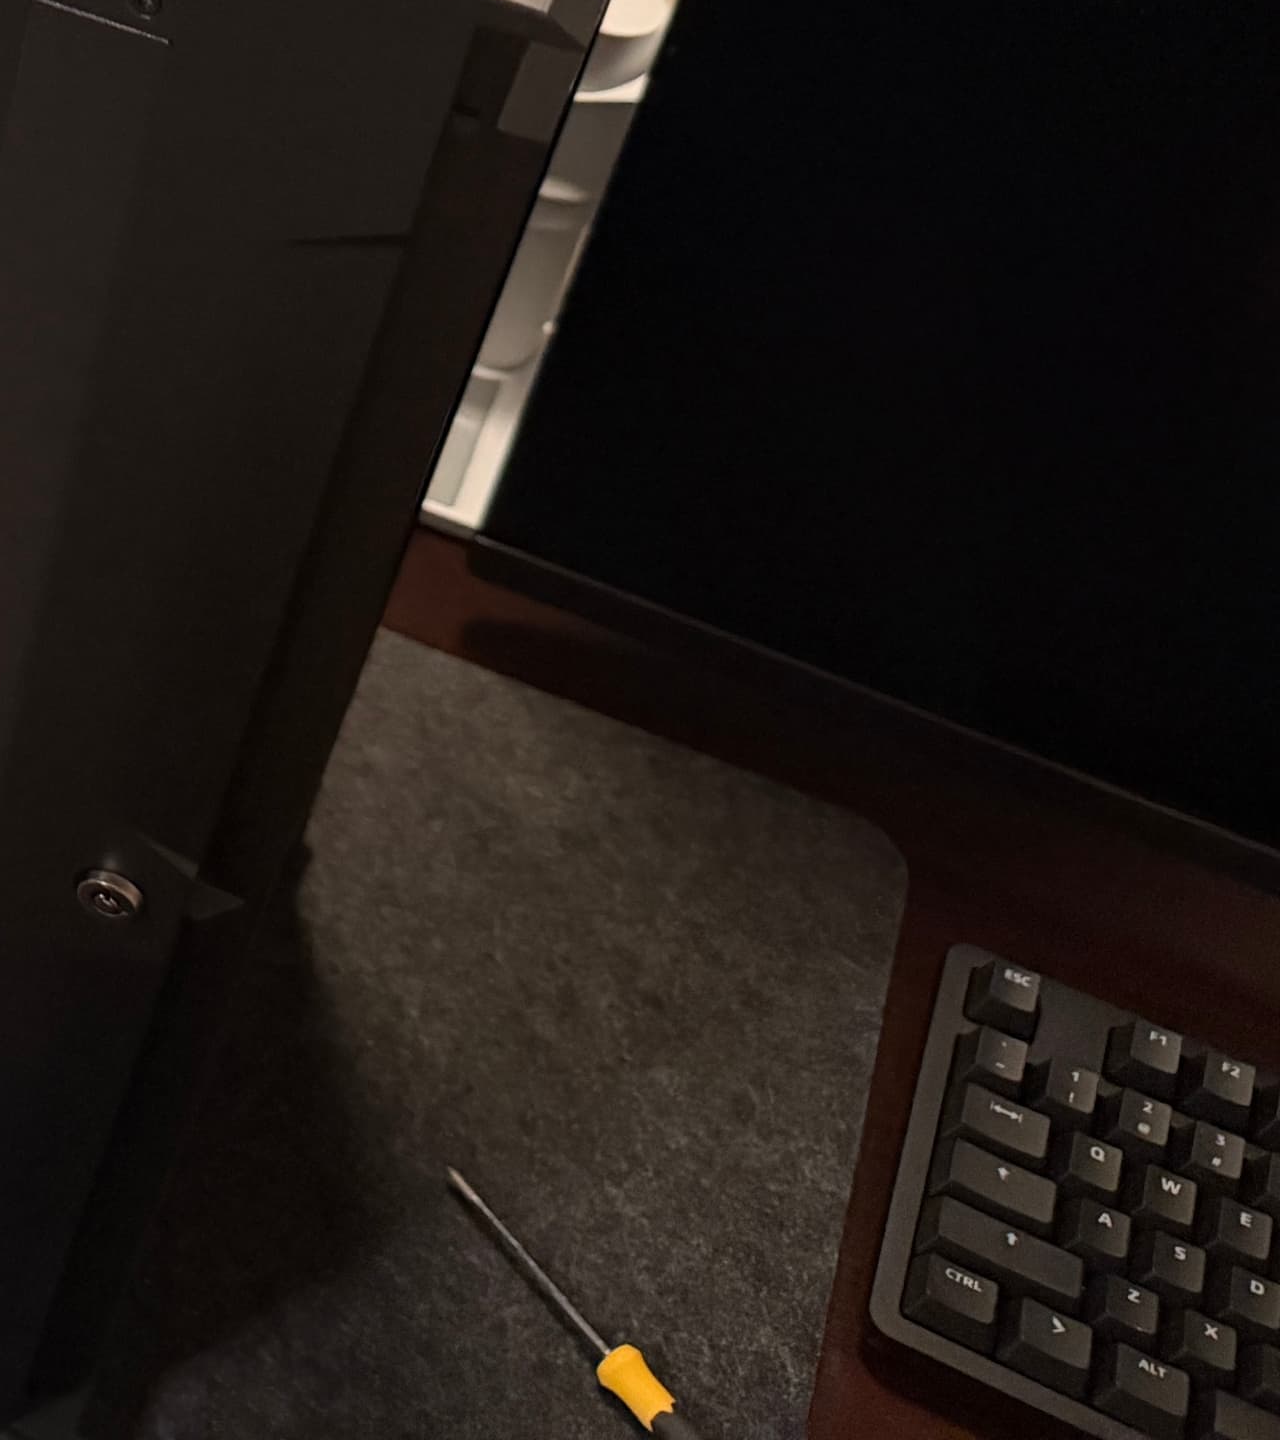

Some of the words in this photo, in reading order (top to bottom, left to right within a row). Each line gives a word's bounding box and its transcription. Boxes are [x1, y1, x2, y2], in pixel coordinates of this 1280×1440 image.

[1004, 968, 1033, 988] ESC
[1149, 1030, 1168, 1047] F1
[1071, 1071, 1080, 1083] 1
[1222, 1062, 1241, 1079] F2
[1142, 1101, 1153, 1114] 2
[1215, 1133, 1226, 1147] 3
[1090, 1146, 1105, 1162] Q
[1161, 1176, 1182, 1196] W
[1097, 1212, 1113, 1228] A
[1240, 1211, 1253, 1229] E
[1174, 1246, 1187, 1261] S
[945, 1267, 983, 1293] CTRL
[1250, 1279, 1265, 1296] D
[1127, 1288, 1141, 1304] Z
[1204, 1322, 1219, 1341] X
[1138, 1358, 1168, 1380] ALT
